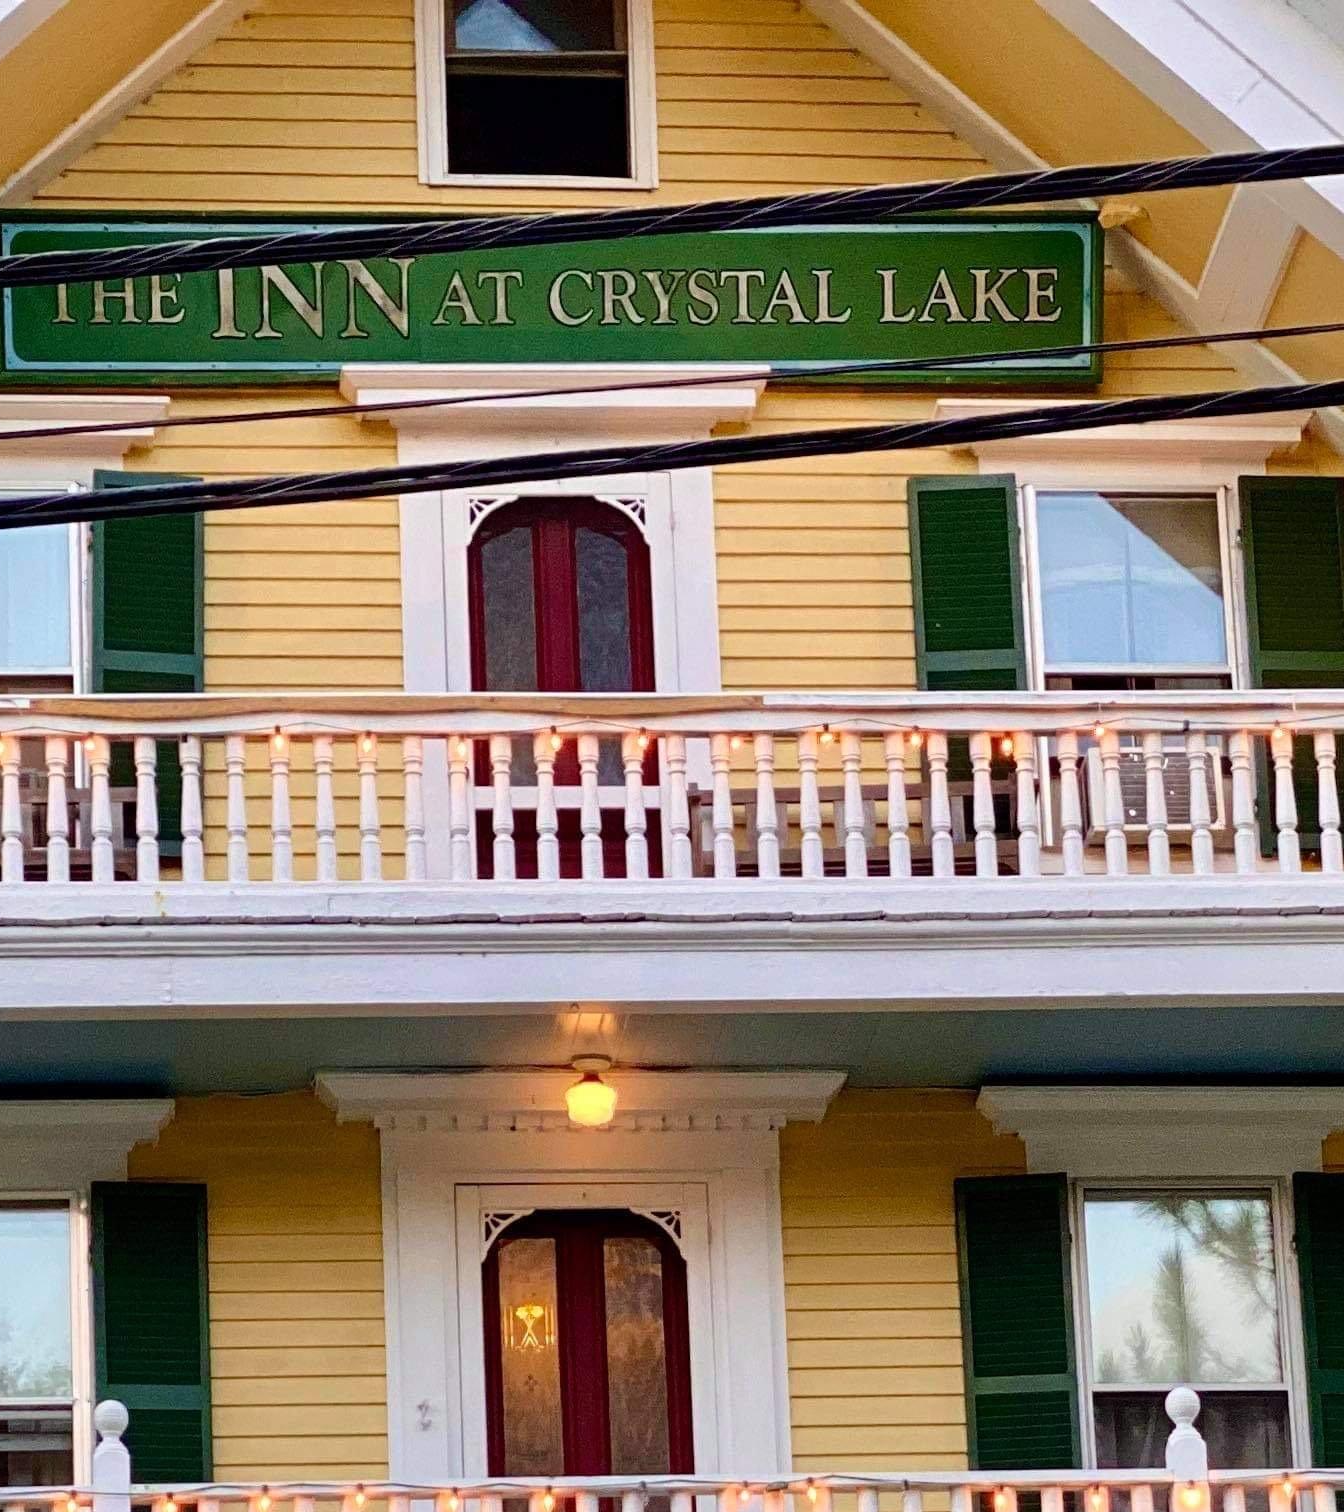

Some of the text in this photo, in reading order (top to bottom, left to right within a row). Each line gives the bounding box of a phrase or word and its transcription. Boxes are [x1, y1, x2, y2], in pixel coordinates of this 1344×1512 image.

[52, 257, 1063, 340] THE INN AT CRYSTAL LAKE
